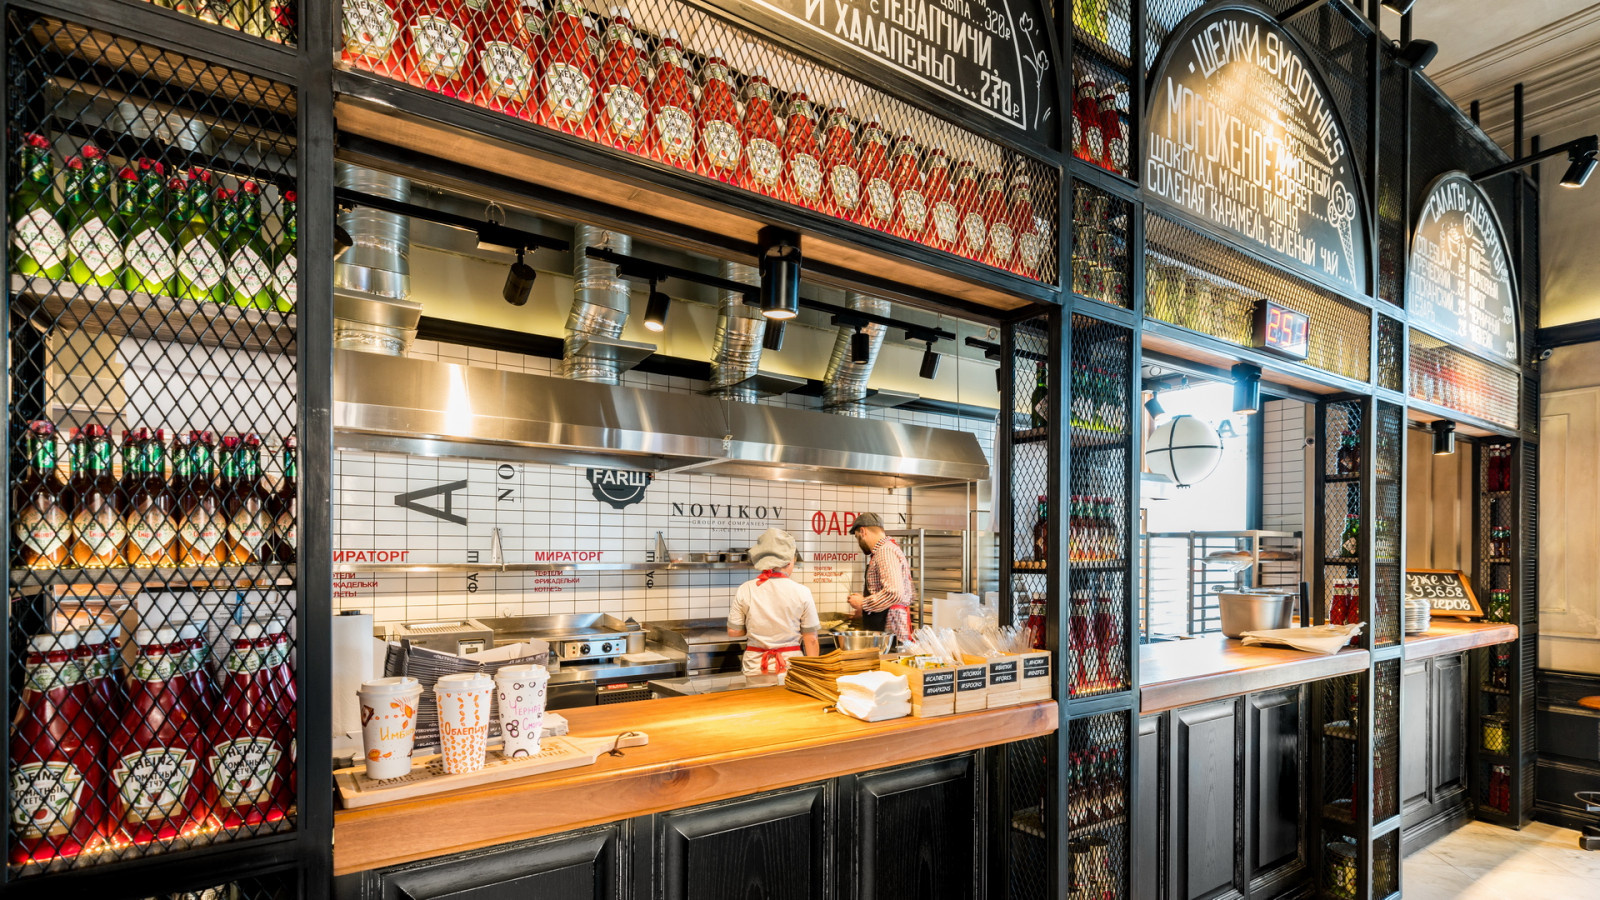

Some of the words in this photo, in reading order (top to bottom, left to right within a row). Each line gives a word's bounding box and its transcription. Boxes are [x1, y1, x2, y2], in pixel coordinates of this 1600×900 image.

[1192, 18, 1260, 79] ШЕЙКИ
[1266, 32, 1345, 165] SMOOTHIES
[1167, 76, 1272, 191] МОРОЖЕНОЕ
[1150, 132, 1218, 192] ШОКОЛАД,
[1219, 167, 1259, 214] МАНГО,
[1263, 190, 1300, 234] ВИШНЯ,
[1275, 145, 1331, 200] ЛИМОННЫЙ
[1147, 159, 1205, 215] СОЛЕНАЯ
[1210, 190, 1267, 247] КАРАМЕЛЬ,
[1269, 220, 1316, 267] ЗЕЛЕНЫЙ
[1430, 182, 1466, 224] САЛАТЫ
[1471, 196, 1505, 275] ДЕСЕРТЫ
[671, 502, 783, 519] NOVIKOV
[812, 511, 859, 536] ФАР
[333, 551, 409, 562] ИРАТОРГ
[534, 551, 604, 561] МИРАТОРГ
[813, 553, 859, 561] МИРАТОРГ
[1413, 585, 1463, 598] 93658
[18, 770, 63, 785] HEINZ
